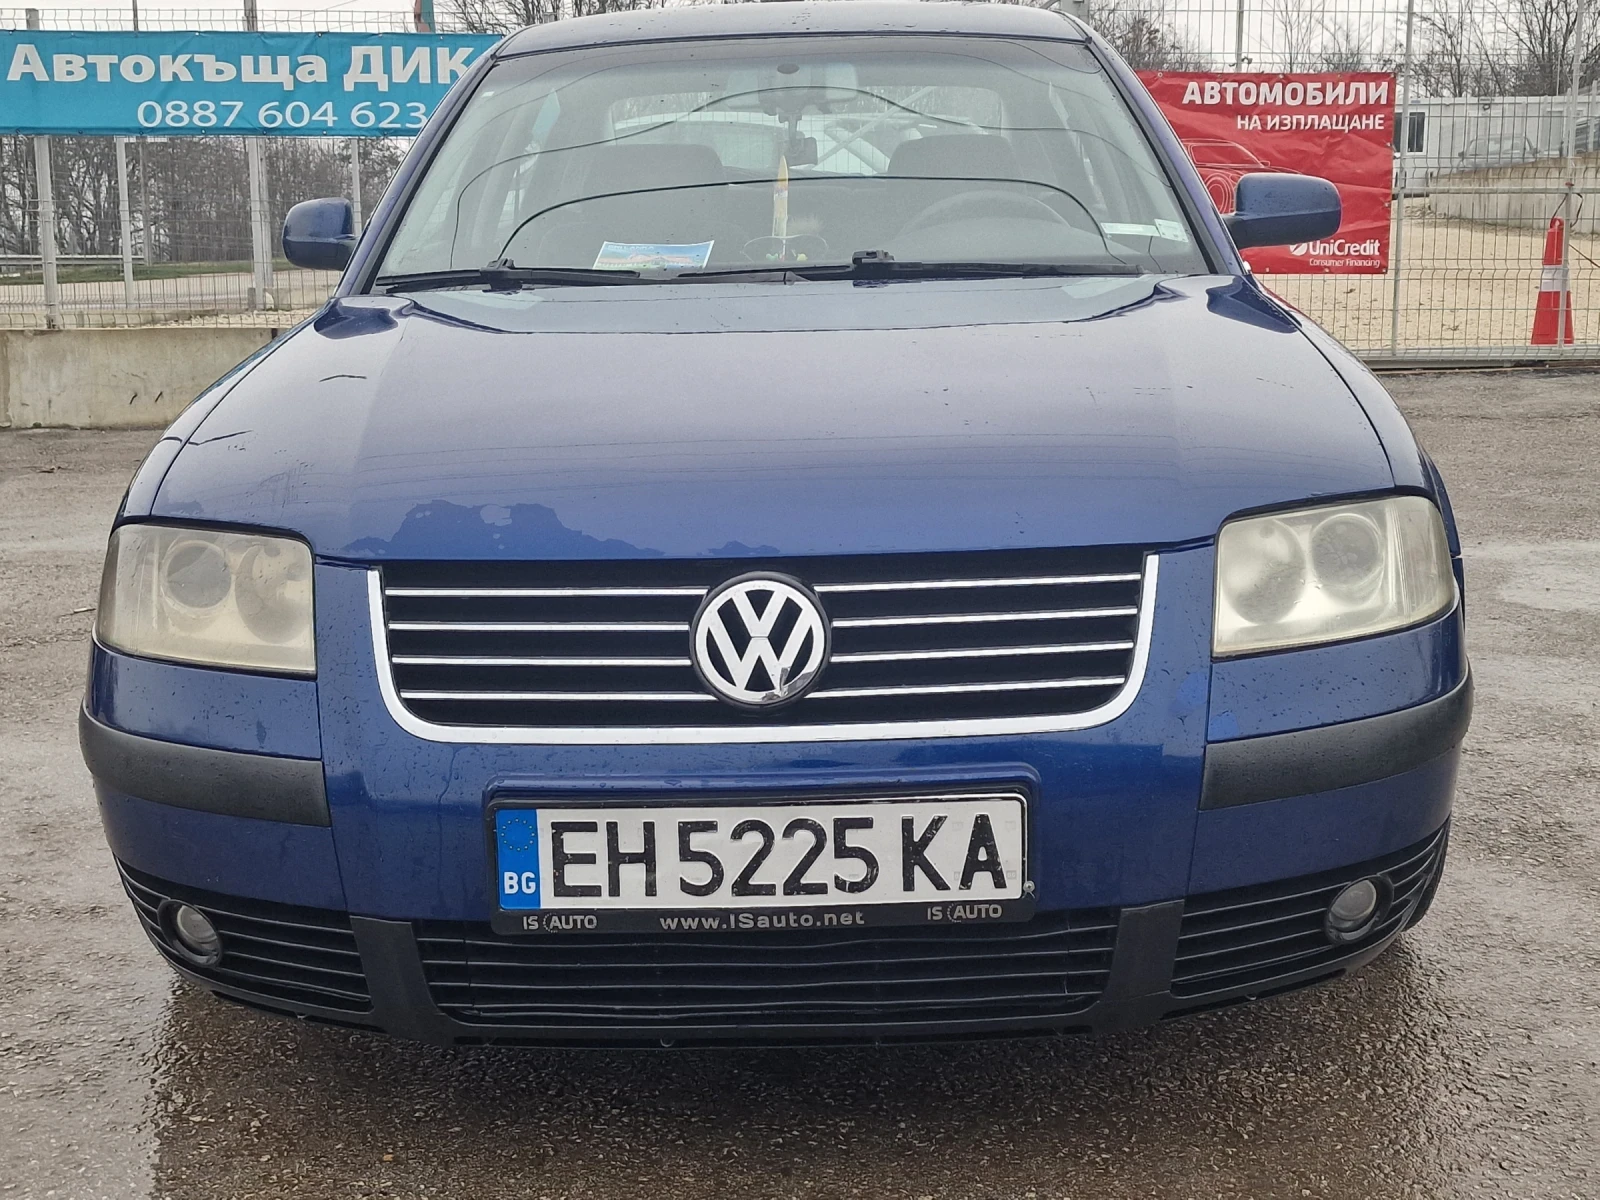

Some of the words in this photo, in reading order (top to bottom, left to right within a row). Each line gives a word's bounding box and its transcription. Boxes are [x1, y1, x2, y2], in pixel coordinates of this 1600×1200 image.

[7, 43, 328, 91] Автокъща
[1182, 82, 1389, 105] АВТОМОБИЛИ
[137, 100, 243, 128] 0887
[257, 101, 338, 128] 604
[350, 101, 428, 129] 623
[1236, 114, 1262, 131] НА
[1266, 114, 1385, 132] ИЗПЛАЩАНЕ
[1309, 239, 1380, 256] UniCredit
[1309, 258, 1344, 267] Consumer
[1346, 258, 1380, 269] Financing
[550, 820, 657, 898] EH
[677, 817, 880, 896] 5225
[901, 813, 1008, 892] KA
[503, 871, 537, 895] BG
[660, 911, 865, 931] www.ISauto.net
